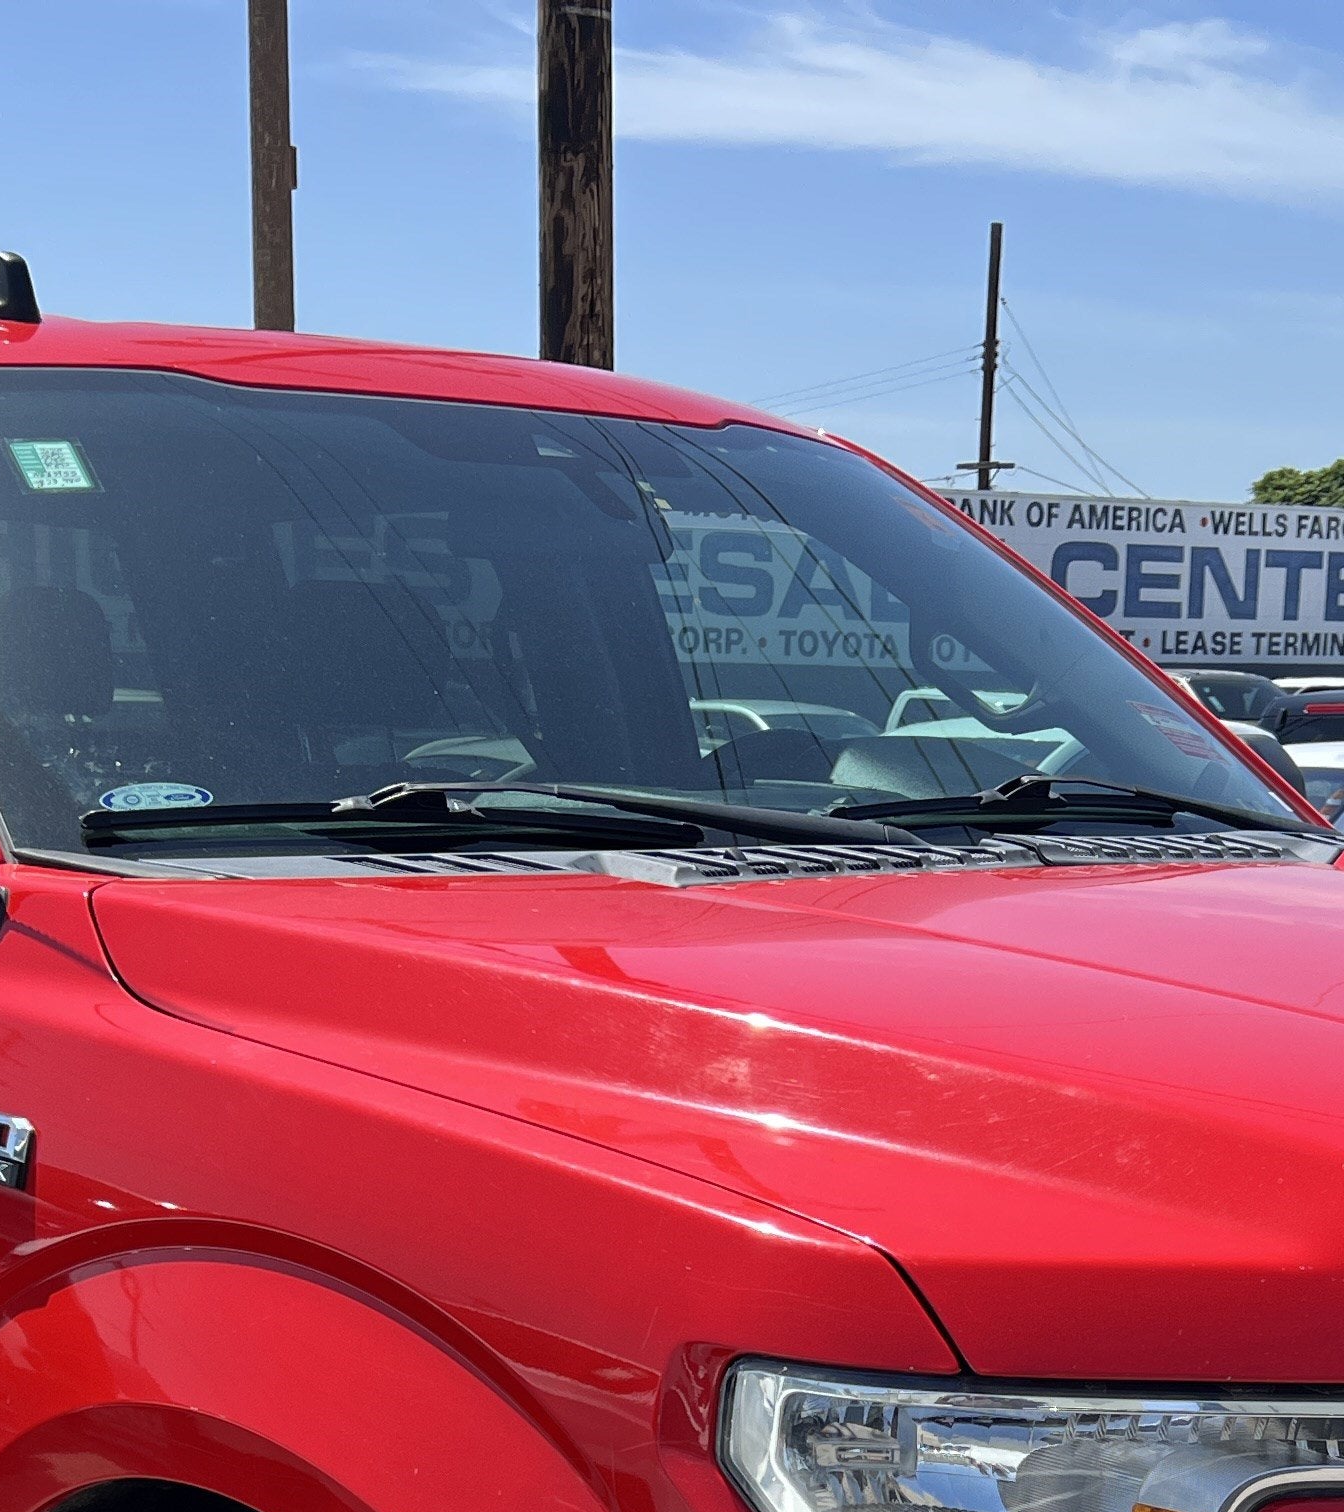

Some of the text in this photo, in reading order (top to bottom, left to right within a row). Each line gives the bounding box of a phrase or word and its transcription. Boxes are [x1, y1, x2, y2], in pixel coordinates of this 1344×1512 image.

[944, 497, 1016, 526] ANK
[1026, 501, 1060, 528] OF
[1067, 503, 1186, 533] AMERICA
[1210, 510, 1288, 537] WELLS
[668, 625, 747, 655] ORP.
[779, 629, 899, 660] TOYOTA
[1161, 630, 1243, 655] LEASE
